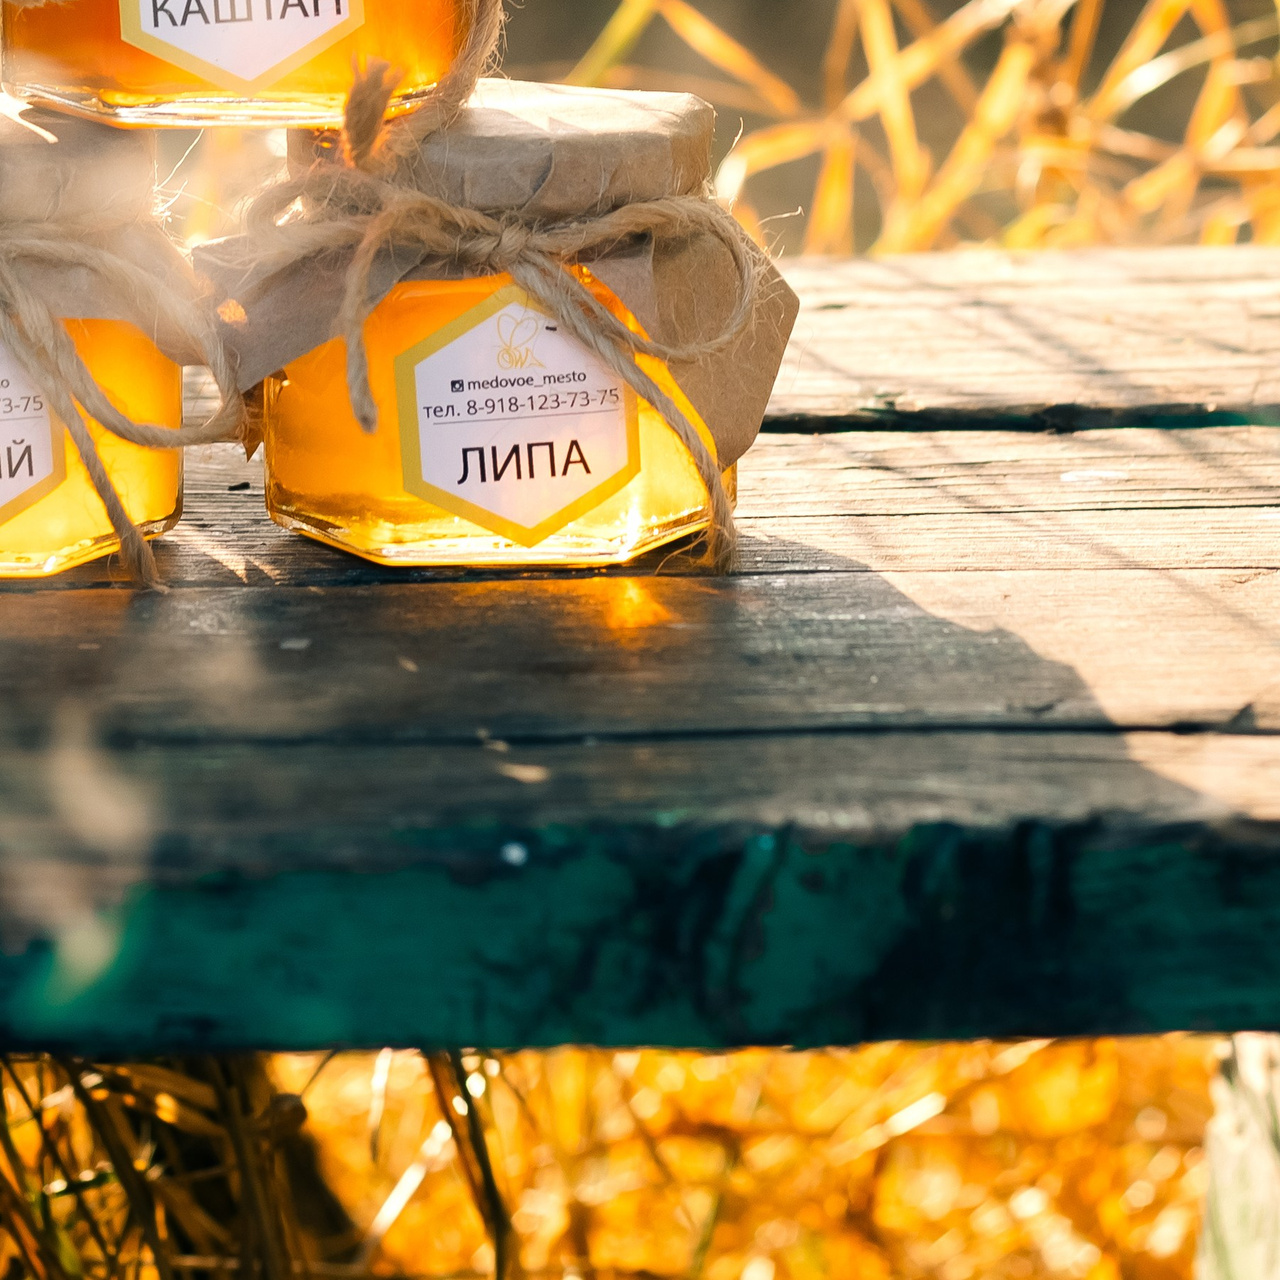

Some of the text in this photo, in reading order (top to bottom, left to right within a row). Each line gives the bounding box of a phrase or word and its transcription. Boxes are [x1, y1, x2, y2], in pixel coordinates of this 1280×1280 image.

[467, 370, 586, 390] medovoe_mesto
[423, 388, 619, 419] тел. 8-918-123-73-75
[457, 440, 591, 485] ЛИПА
